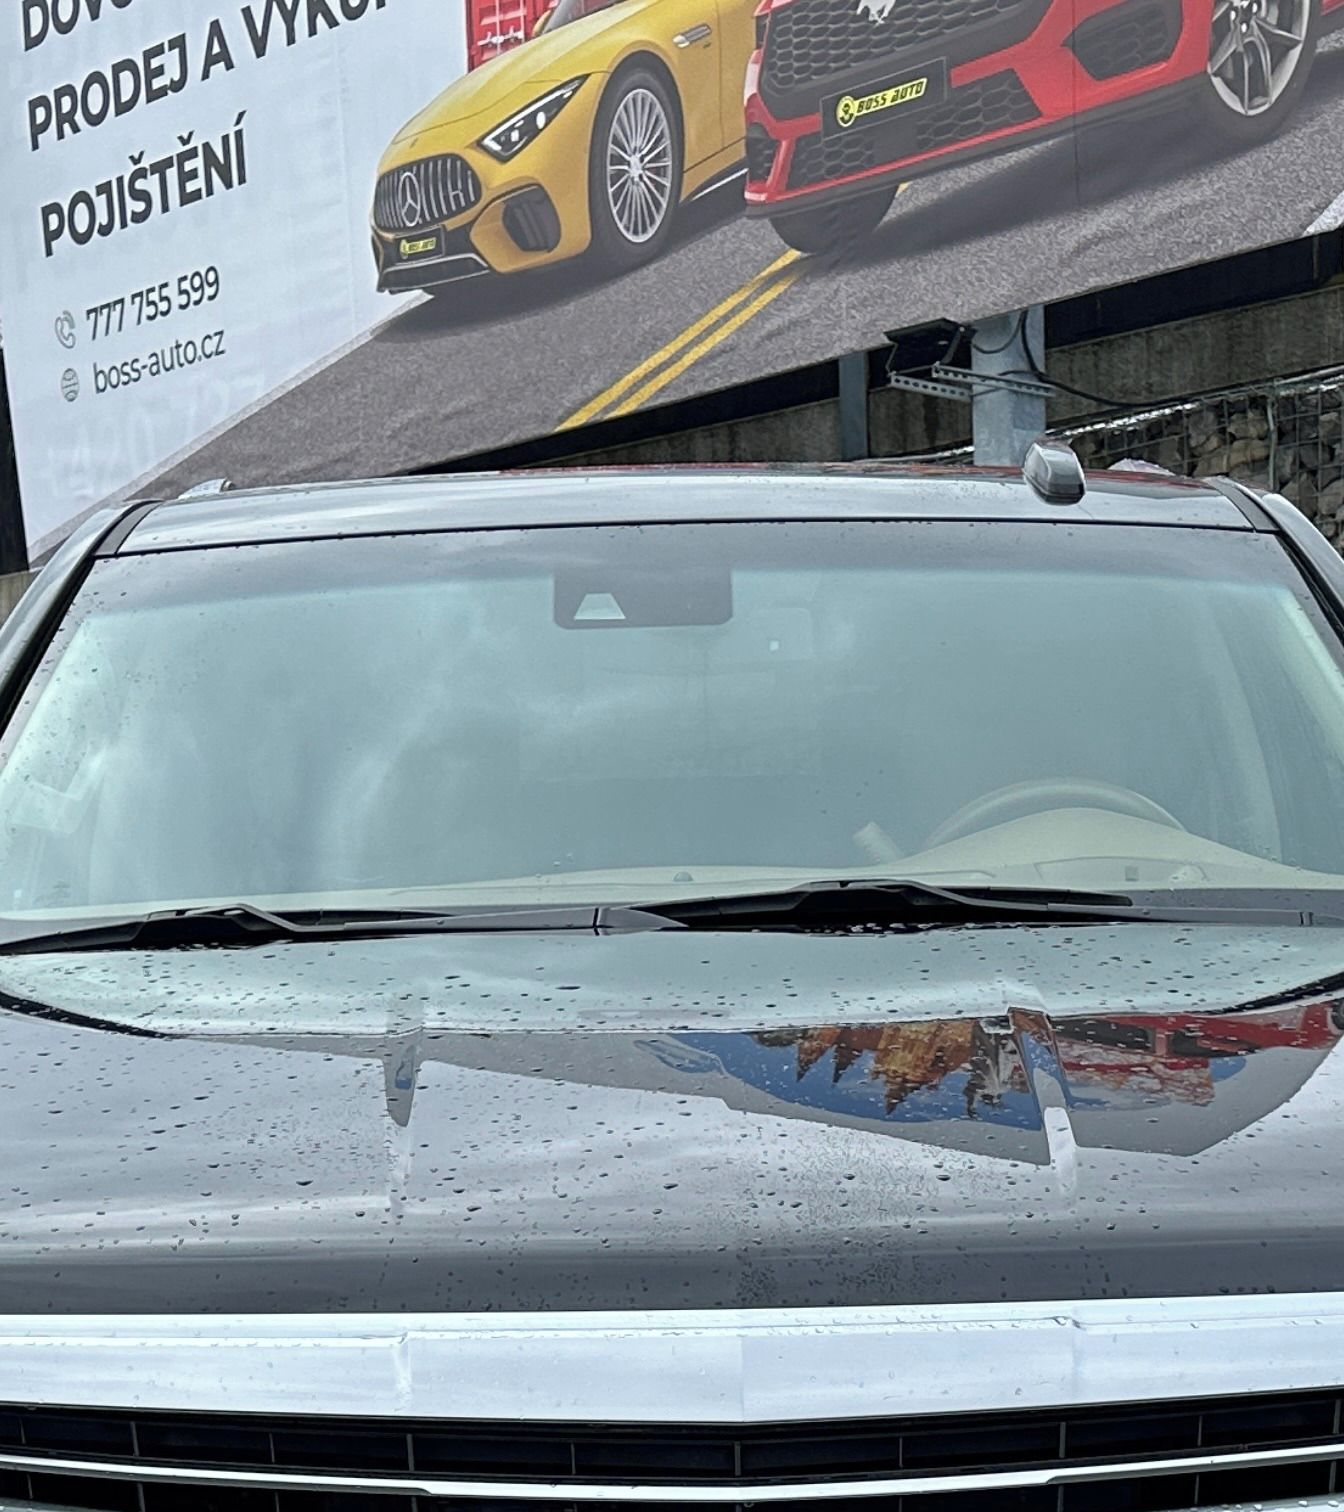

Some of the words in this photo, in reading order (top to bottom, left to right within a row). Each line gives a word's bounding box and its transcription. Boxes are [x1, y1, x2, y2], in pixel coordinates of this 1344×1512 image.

[28, 33, 188, 151] PRODEJ
[201, 19, 235, 81] A
[857, 94, 888, 113] BOSS
[891, 81, 924, 103] AUTO
[41, 110, 247, 257] POJIŠTĚNÍ
[86, 297, 125, 341] 777
[131, 282, 172, 326] 755
[177, 266, 219, 310] 599
[93, 330, 226, 394] boss-auto.cz
